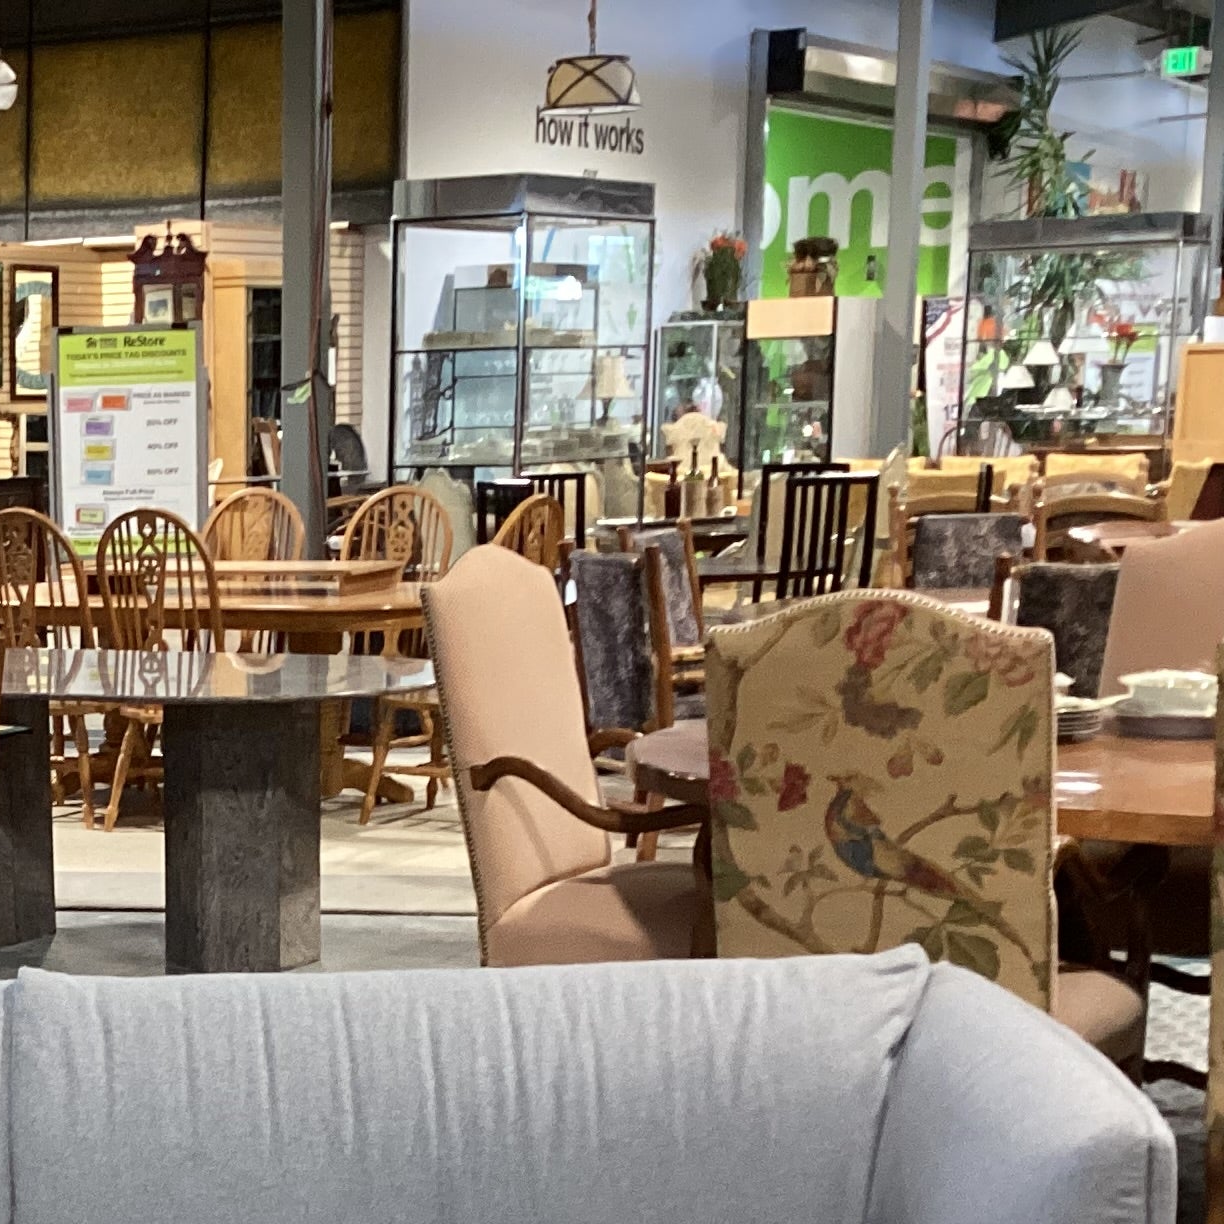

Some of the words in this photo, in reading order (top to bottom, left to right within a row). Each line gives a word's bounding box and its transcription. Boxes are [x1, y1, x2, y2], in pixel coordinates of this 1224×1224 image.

[535, 105, 574, 147] how
[578, 115, 589, 148] it
[594, 117, 645, 155] works
[123, 335, 167, 348] ReStore
